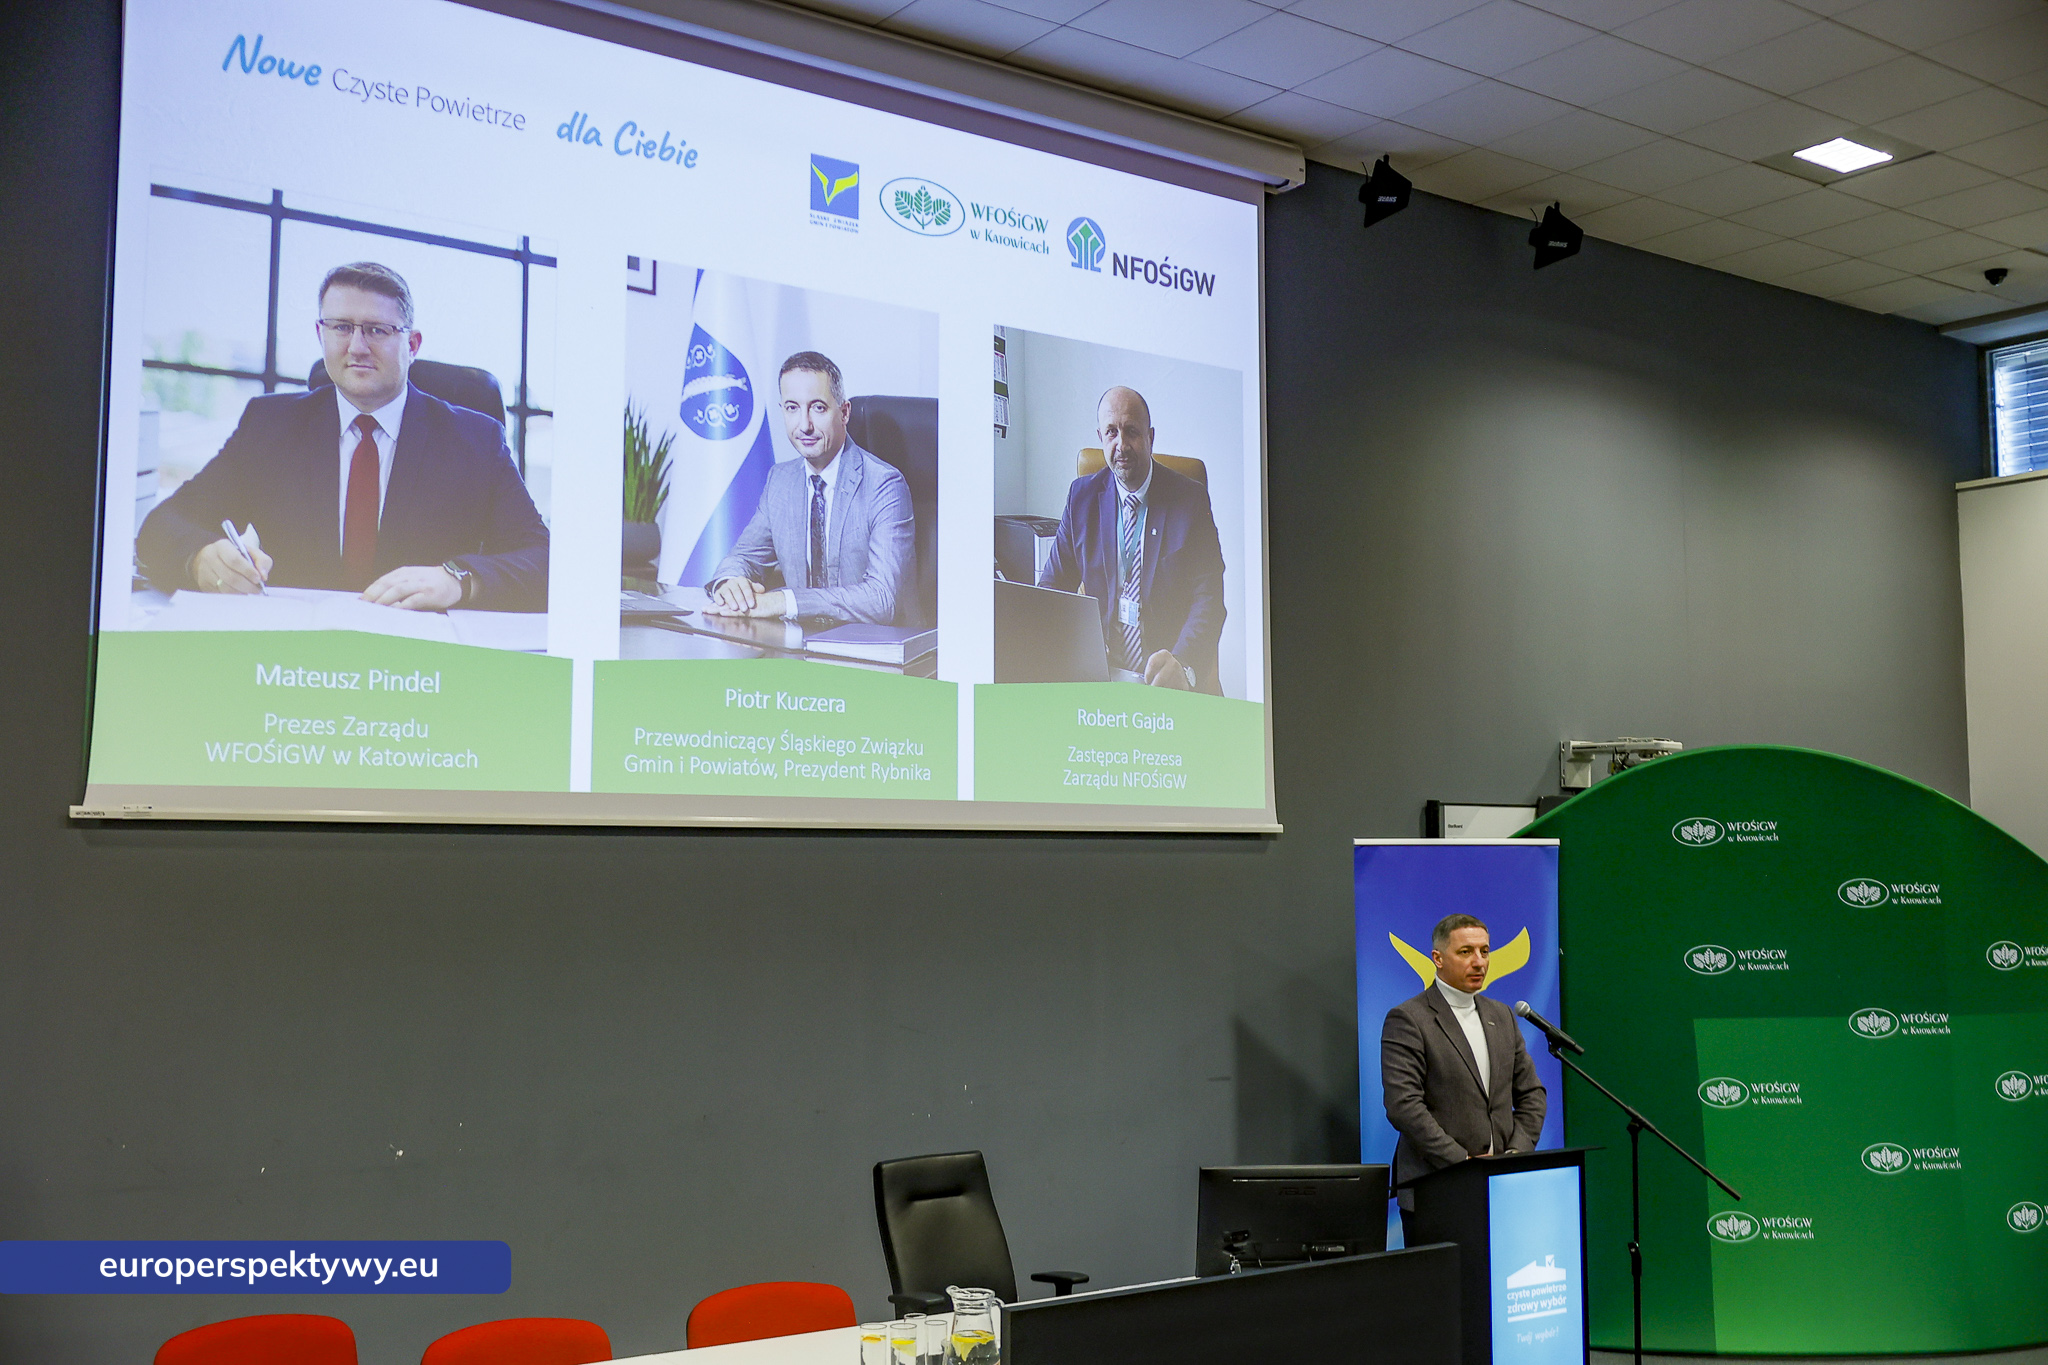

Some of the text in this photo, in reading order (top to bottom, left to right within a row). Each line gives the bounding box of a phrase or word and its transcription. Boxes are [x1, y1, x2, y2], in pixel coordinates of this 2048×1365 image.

[222, 33, 699, 169] Nowe Czyste Powietrze dla Ciebie
[1112, 252, 1216, 297] NFOŚiGW
[255, 663, 441, 694] Mateusz Pindel
[725, 688, 846, 713] Piotr Kuczera
[264, 713, 429, 743] Prezes Zarządu
[1077, 708, 1174, 734] Robert Gajda
[205, 738, 479, 769] WFOŚiGW w Katowicach
[634, 727, 925, 758] Przewodniczący Śląskiego Związku
[1068, 746, 1183, 767] Zastępca Prezesa
[624, 754, 932, 784] Gmin i Powiatów, Prezydent Rybnika
[1063, 768, 1187, 790] Zarządu NFOŚiGW
[1507, 1284, 1566, 1301] czyste powietrze
[1507, 1295, 1567, 1314] zdrowy wybór
